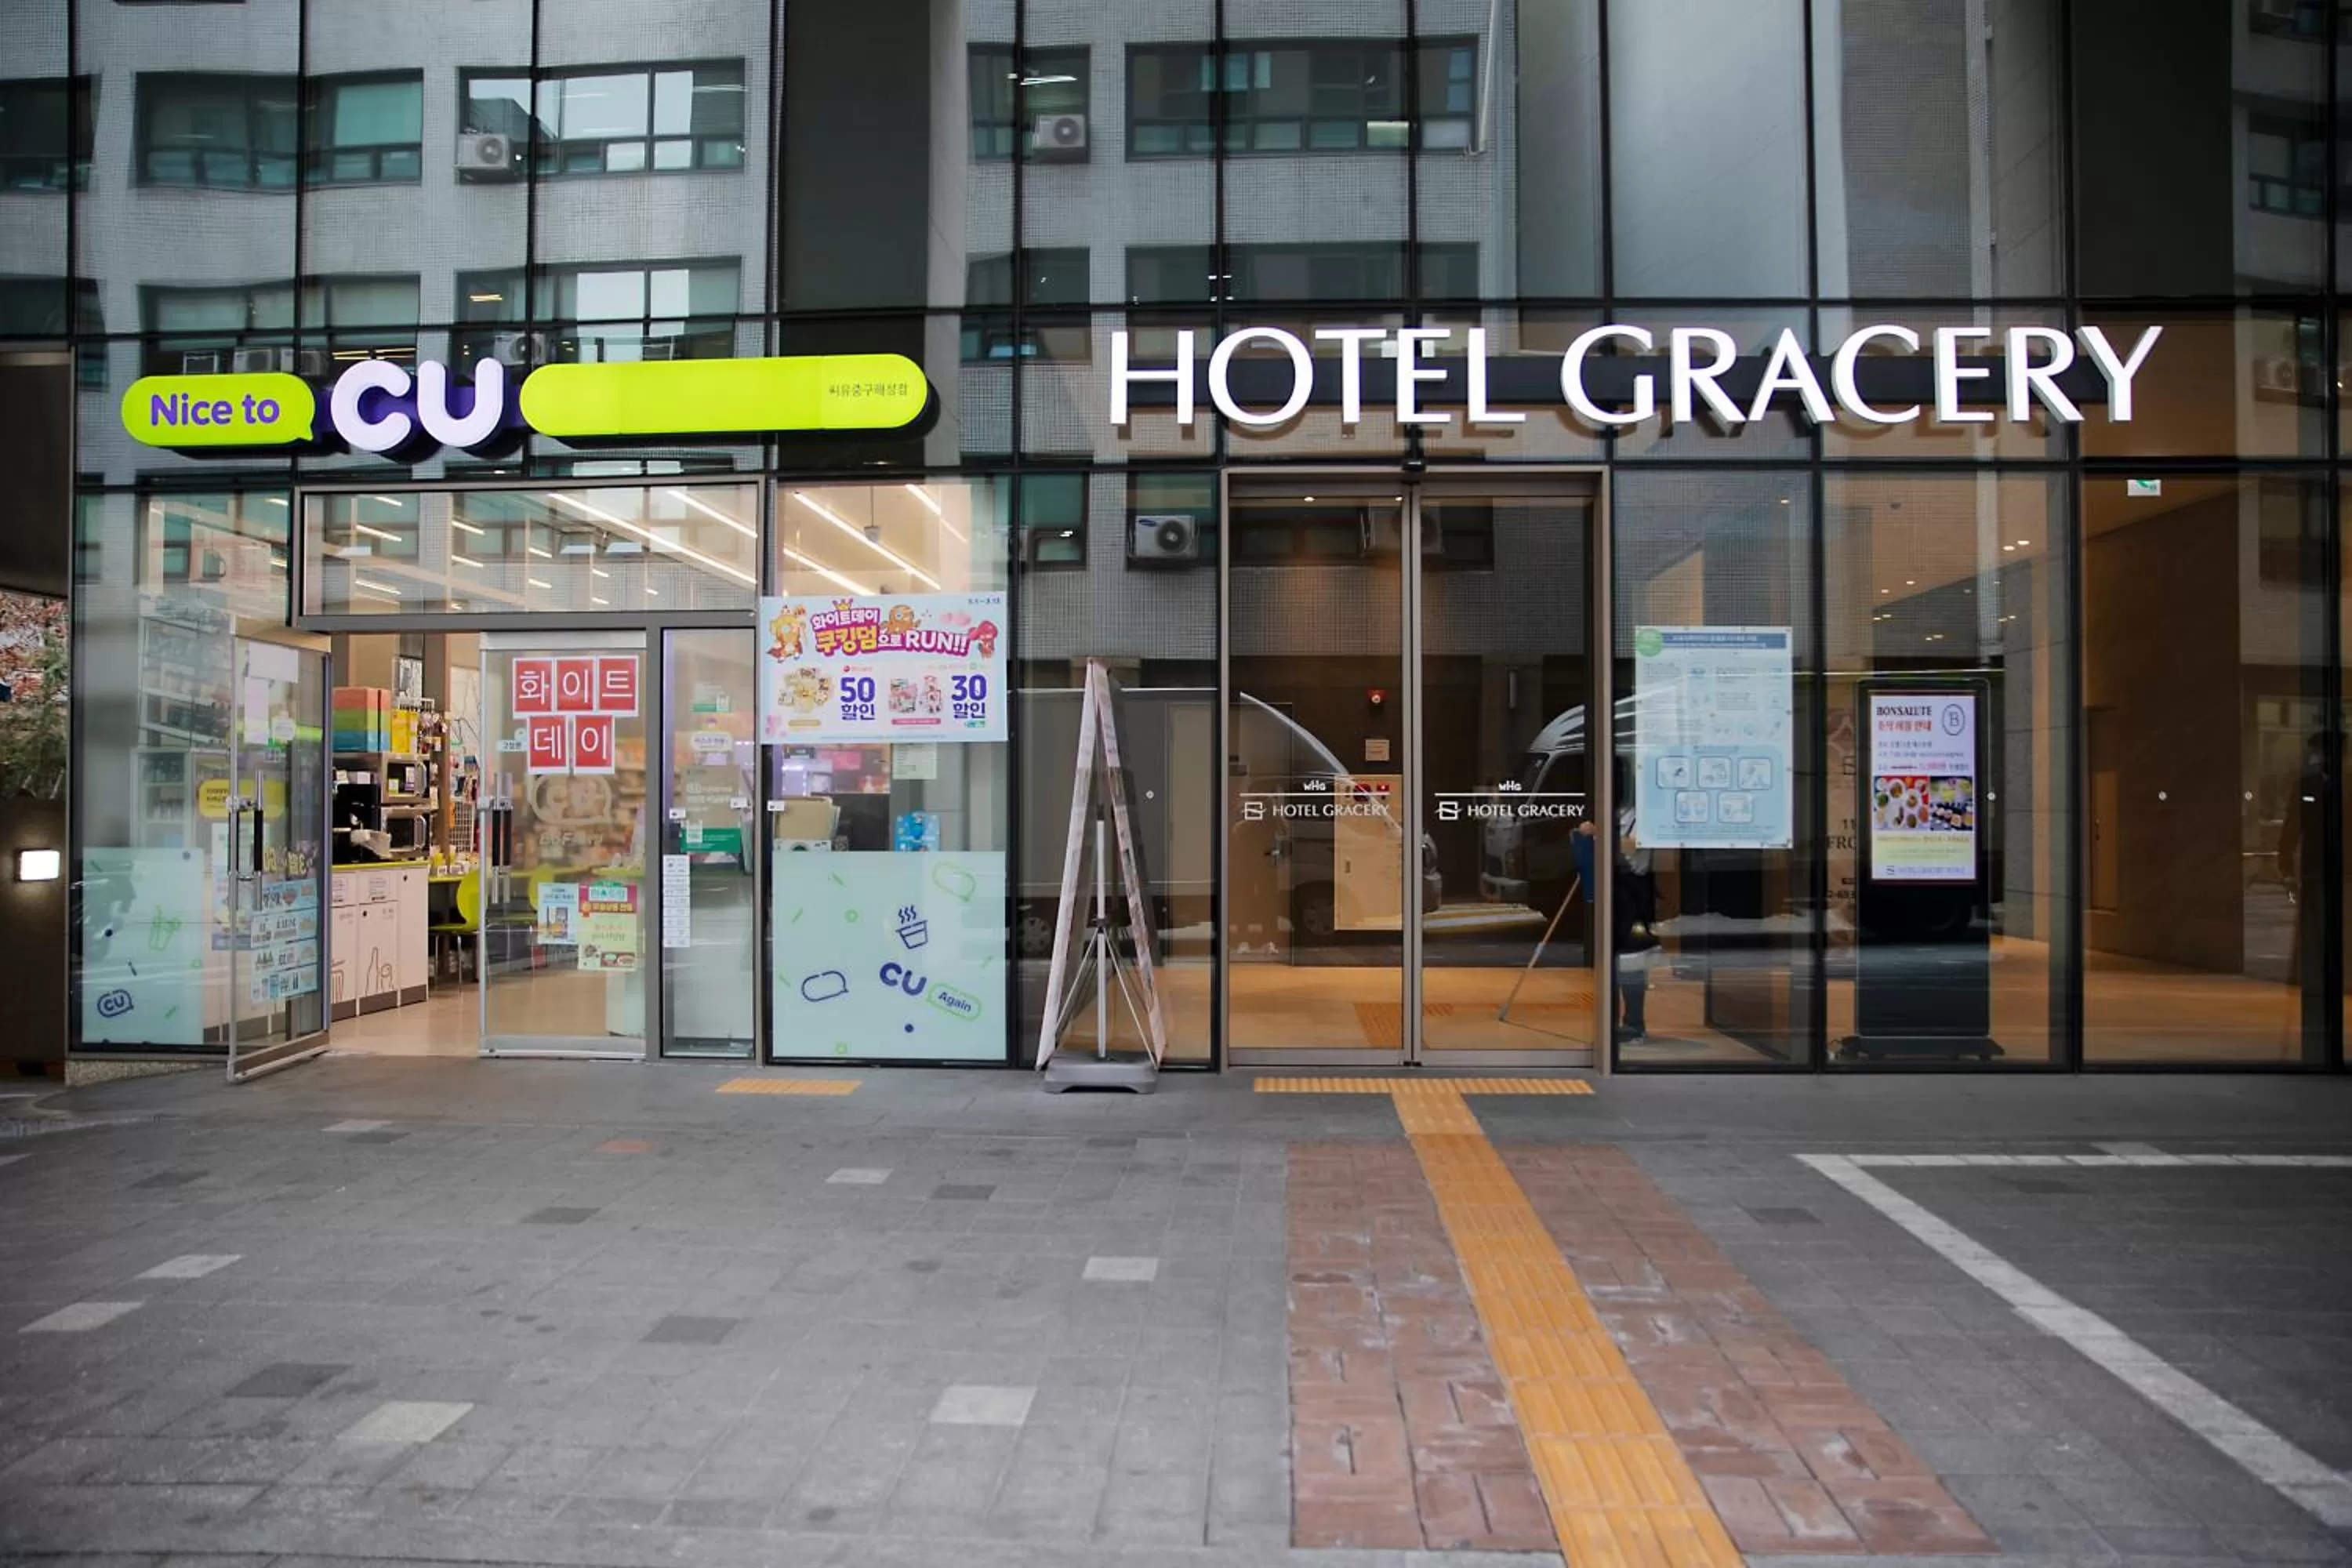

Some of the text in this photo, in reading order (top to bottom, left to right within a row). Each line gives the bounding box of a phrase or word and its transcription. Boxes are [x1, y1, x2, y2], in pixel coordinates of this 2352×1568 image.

[1110, 325, 2164, 425] HOTEL GRACERY
[151, 357, 504, 452] Nice to CU
[811, 608, 878, 630] 화이트데이
[906, 630, 967, 652] RUN!!
[518, 669, 633, 705] 화이트
[840, 677, 876, 703] 50
[951, 674, 987, 702] 30
[841, 704, 876, 720] 할인
[953, 702, 986, 719] 할인
[1876, 705, 1933, 717] BONSALUTE
[534, 724, 607, 760] 데이
[1272, 804, 1390, 817] HOTEL GRACERY
[1467, 804, 1585, 817] HOTEL GRACERY
[880, 962, 972, 1012] CU Again
[103, 995, 125, 1011] CU
